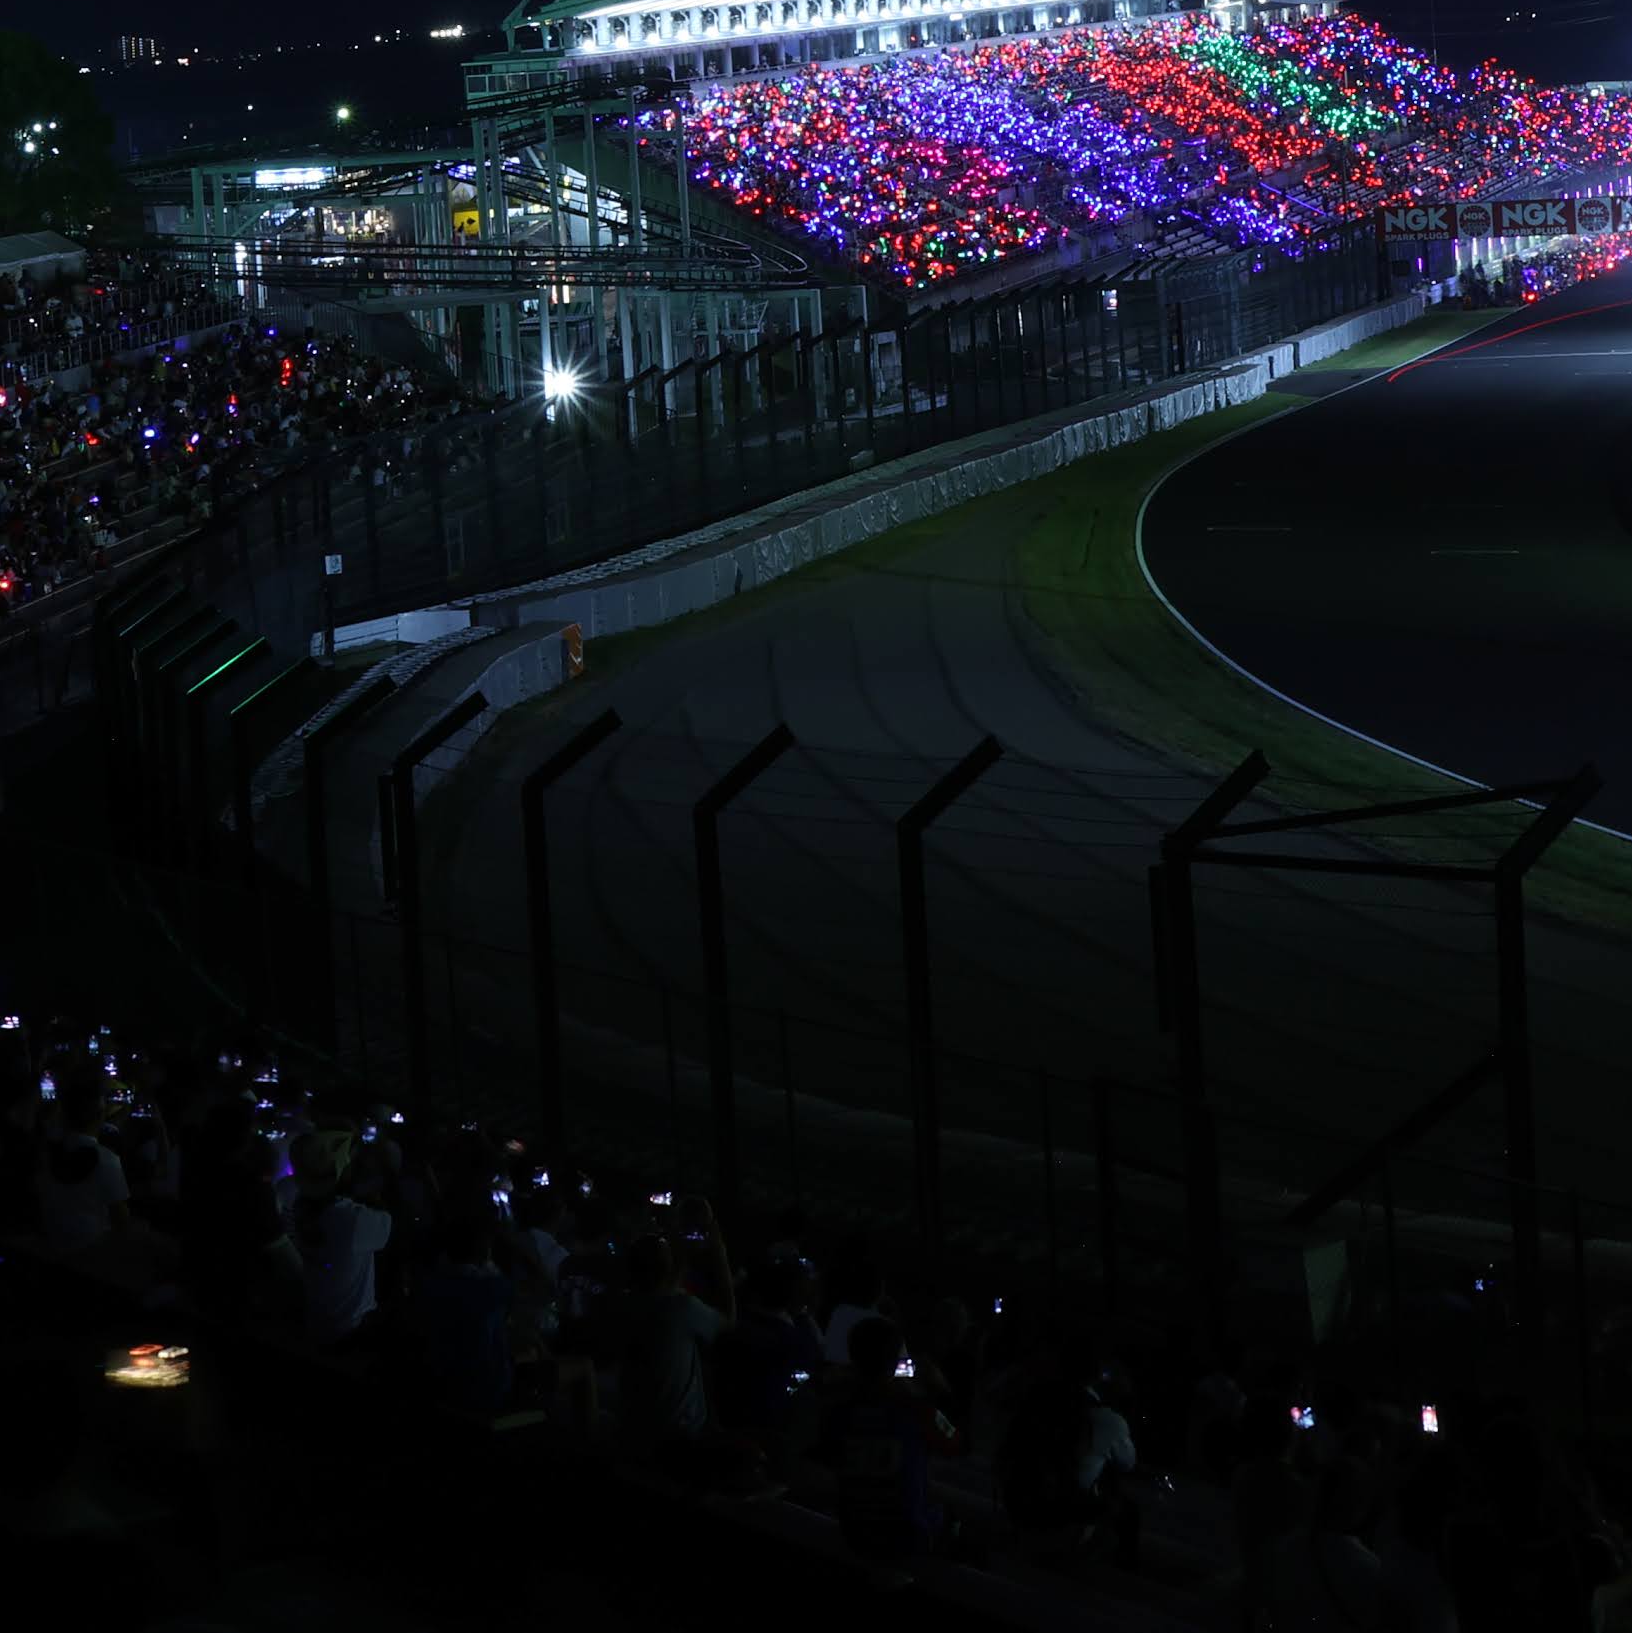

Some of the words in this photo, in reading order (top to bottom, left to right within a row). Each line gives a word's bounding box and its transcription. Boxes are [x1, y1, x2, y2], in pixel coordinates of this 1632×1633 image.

[1463, 211, 1486, 221] NGK
[1501, 200, 1567, 227] NGK
[1581, 206, 1604, 216] NGK
[1383, 206, 1449, 233] NGK
[1502, 227, 1534, 237] SPARK
[1535, 226, 1568, 236] PLUGS
[1384, 233, 1416, 242] SPARK
[1418, 232, 1450, 241] PLUGS
